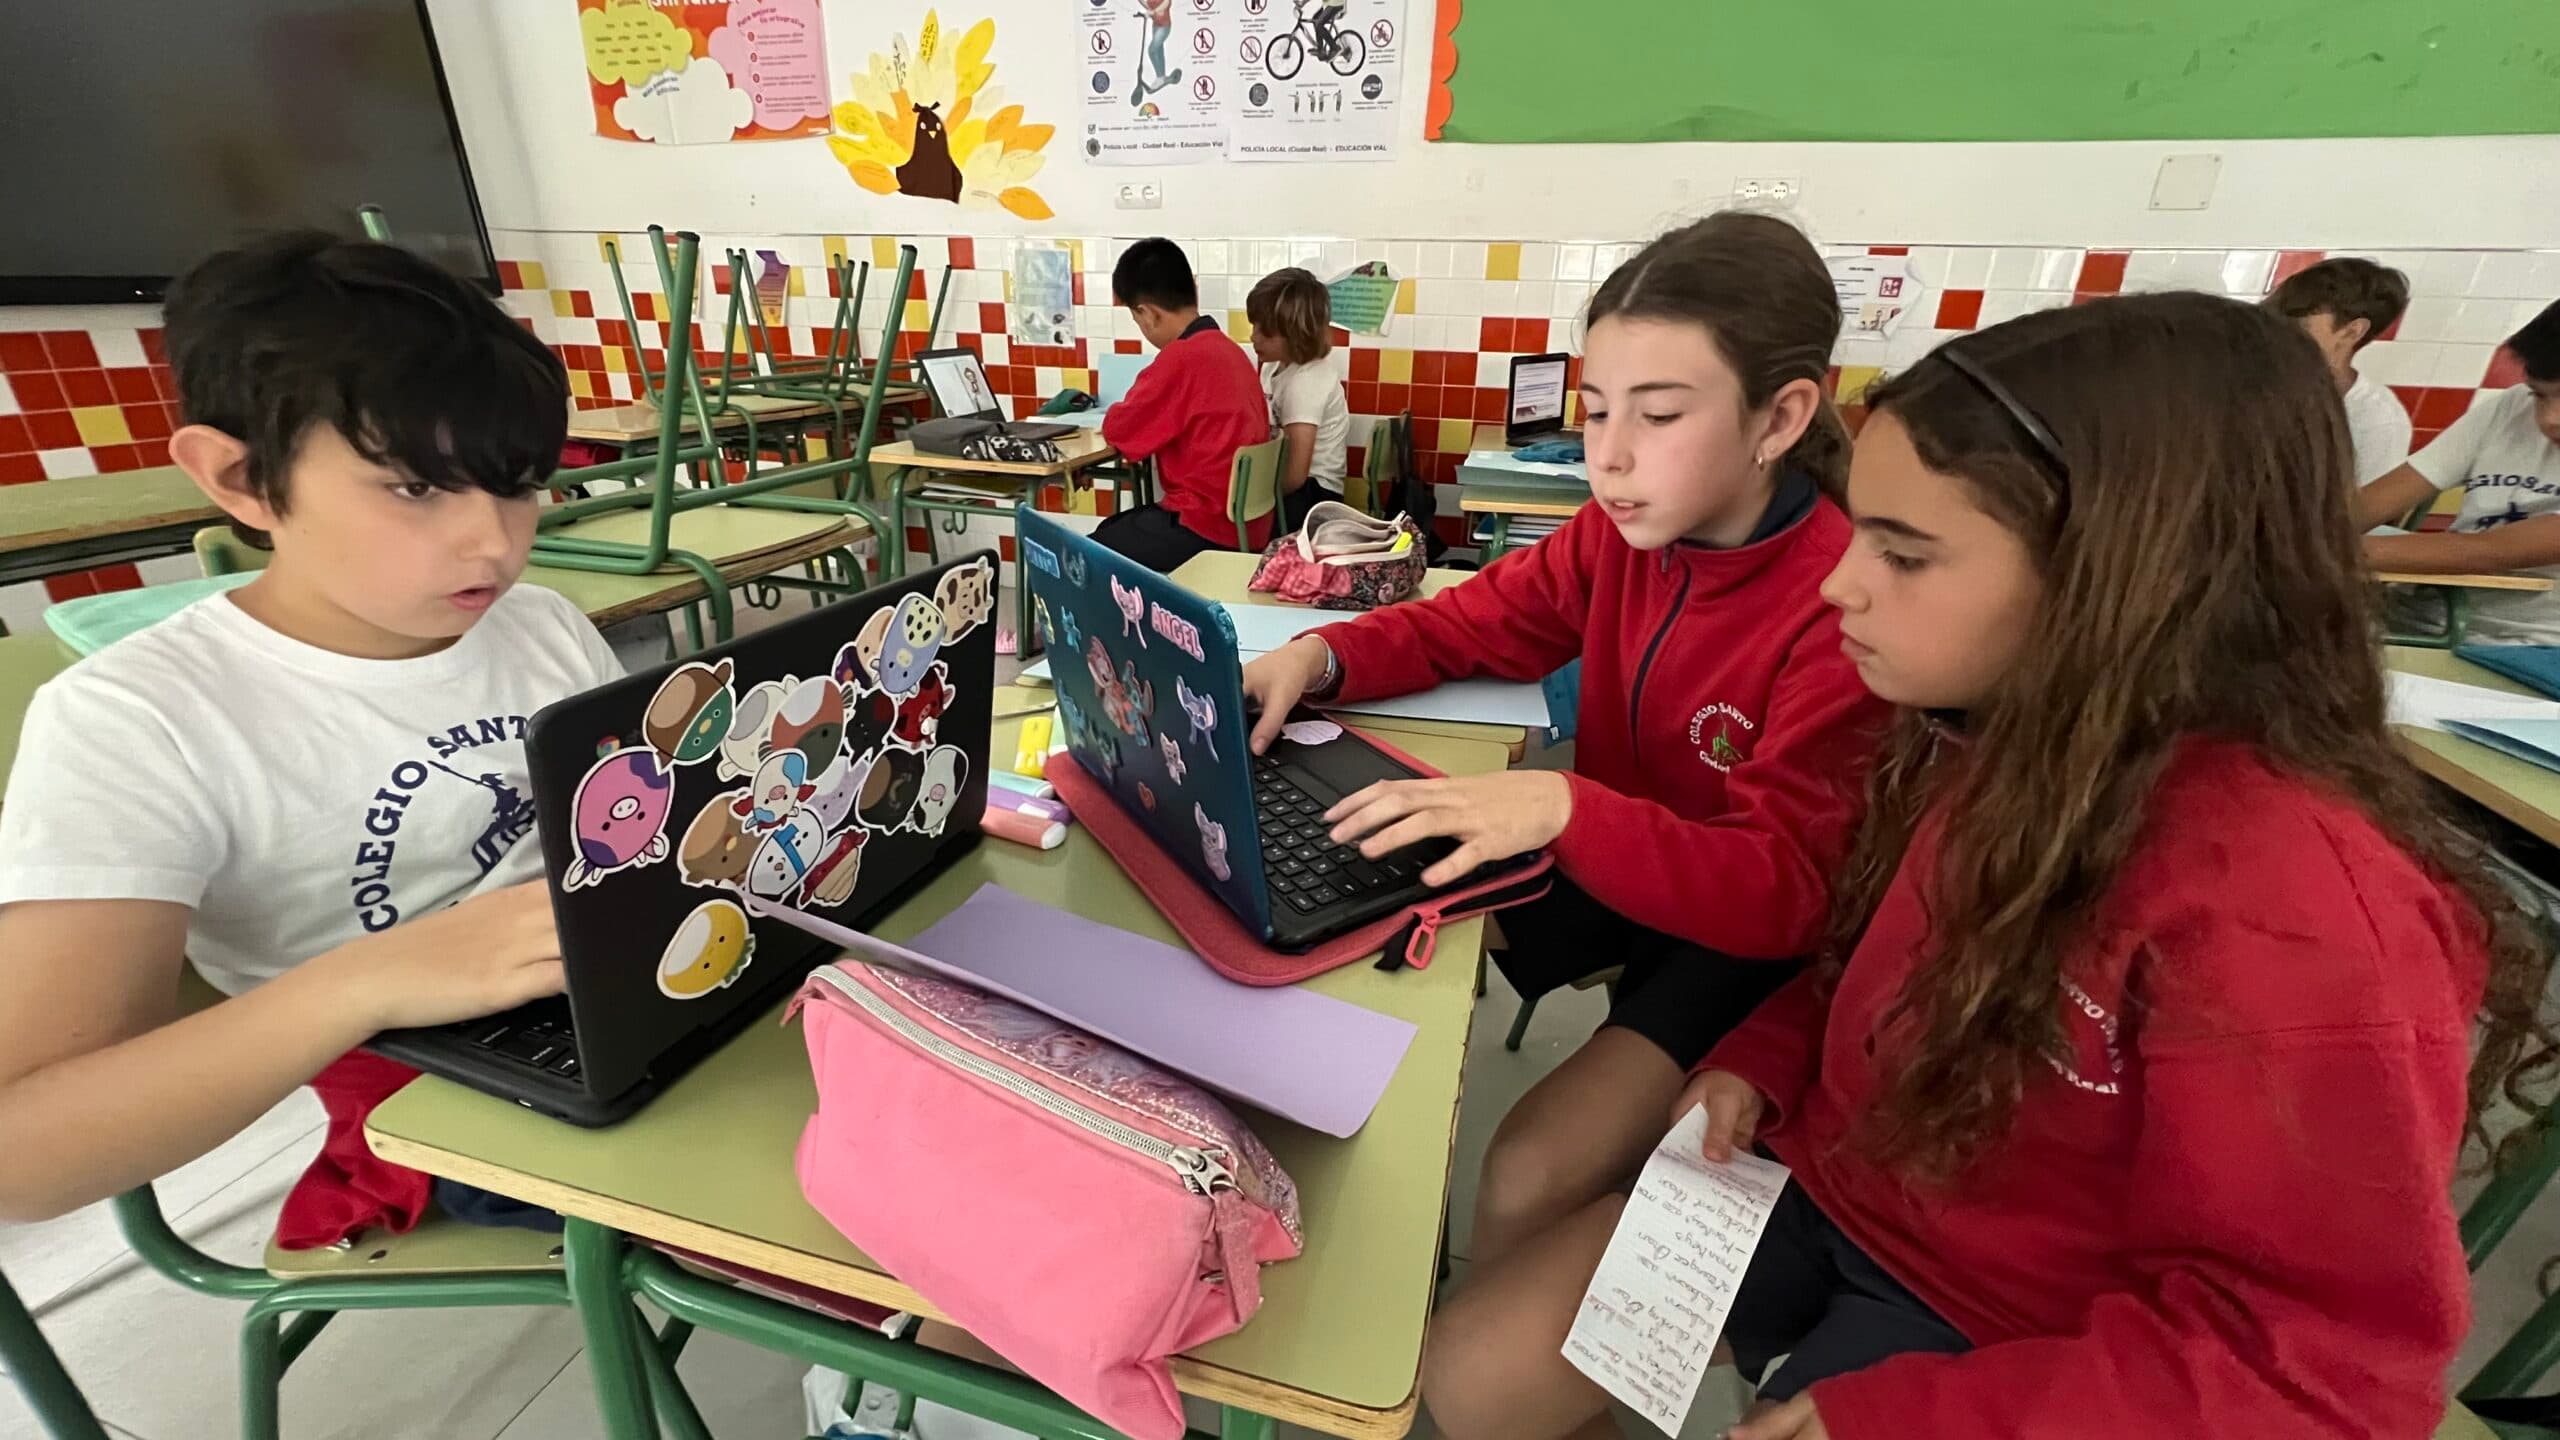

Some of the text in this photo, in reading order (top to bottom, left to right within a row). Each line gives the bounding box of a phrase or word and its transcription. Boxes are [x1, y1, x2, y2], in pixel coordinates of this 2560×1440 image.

[1266, 145, 1287, 153] LOCAL
[1152, 603, 1203, 660] ANGEL
[1689, 702, 1754, 745] COLEGIO SANTO
[351, 715, 529, 933] COLEGIO SANT
